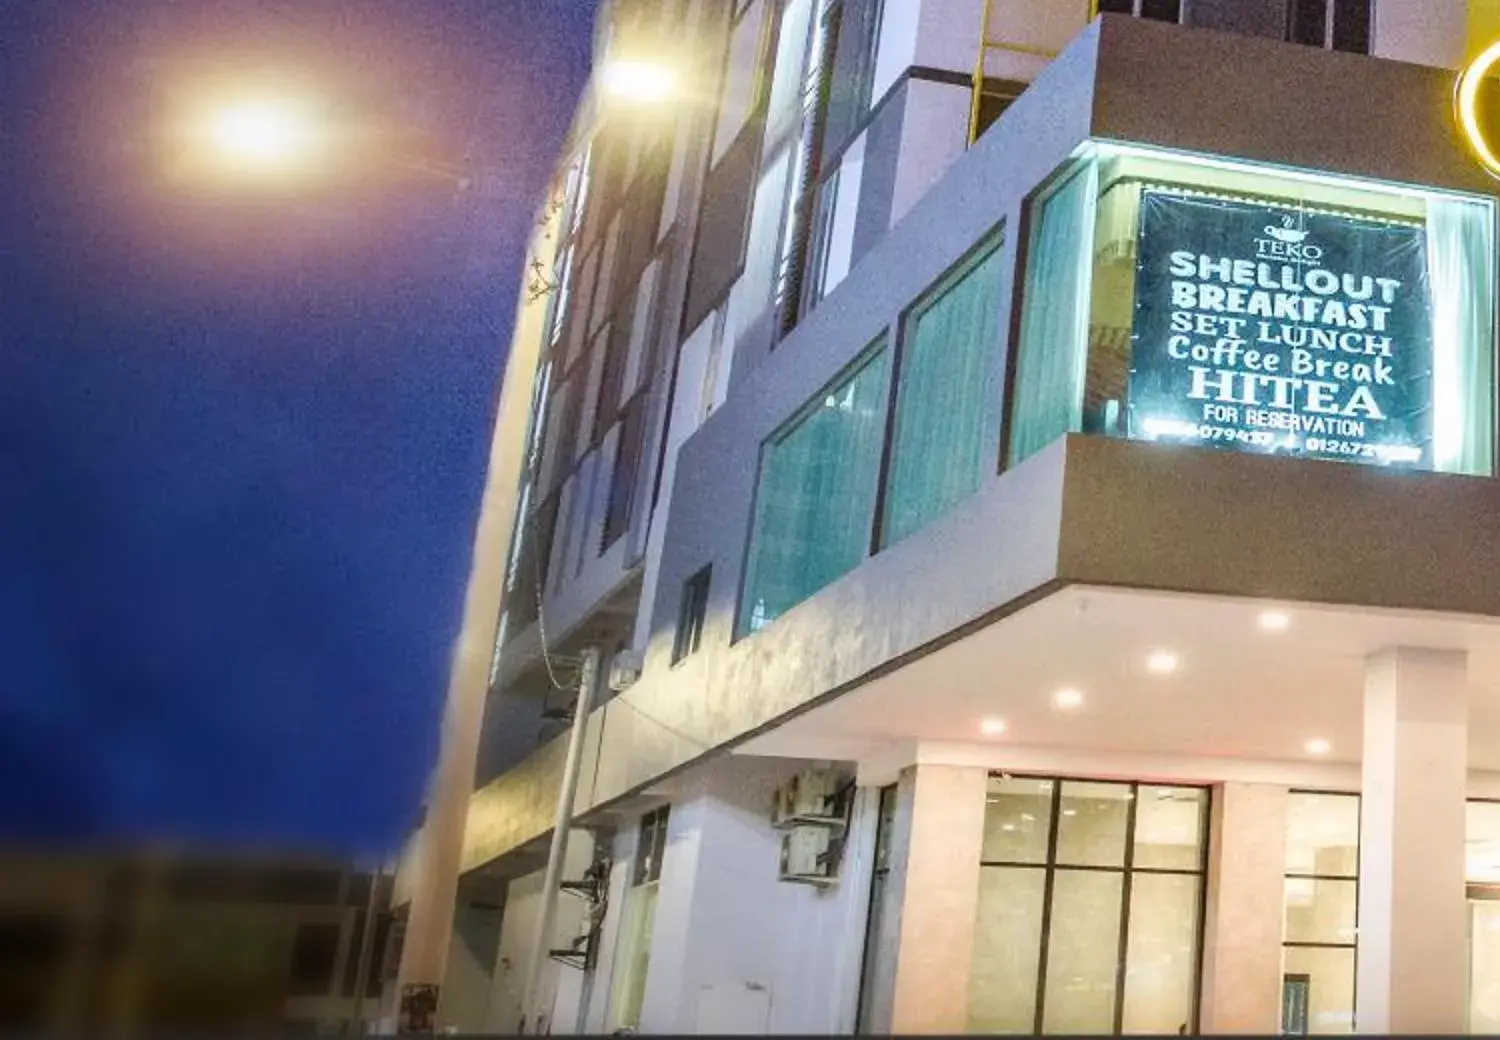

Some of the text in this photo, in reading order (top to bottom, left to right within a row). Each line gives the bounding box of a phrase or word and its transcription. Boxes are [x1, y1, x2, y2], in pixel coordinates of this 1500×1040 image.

[1253, 238, 1322, 259] TEKO
[1169, 251, 1401, 303] SHELLOUT
[1171, 281, 1391, 331] BREAKFAST
[1170, 311, 1393, 357] SET LUNCH
[1168, 335, 1395, 385] Coffee Break
[1203, 403, 1238, 423] FOR
[1245, 409, 1365, 438] RESERVATION
